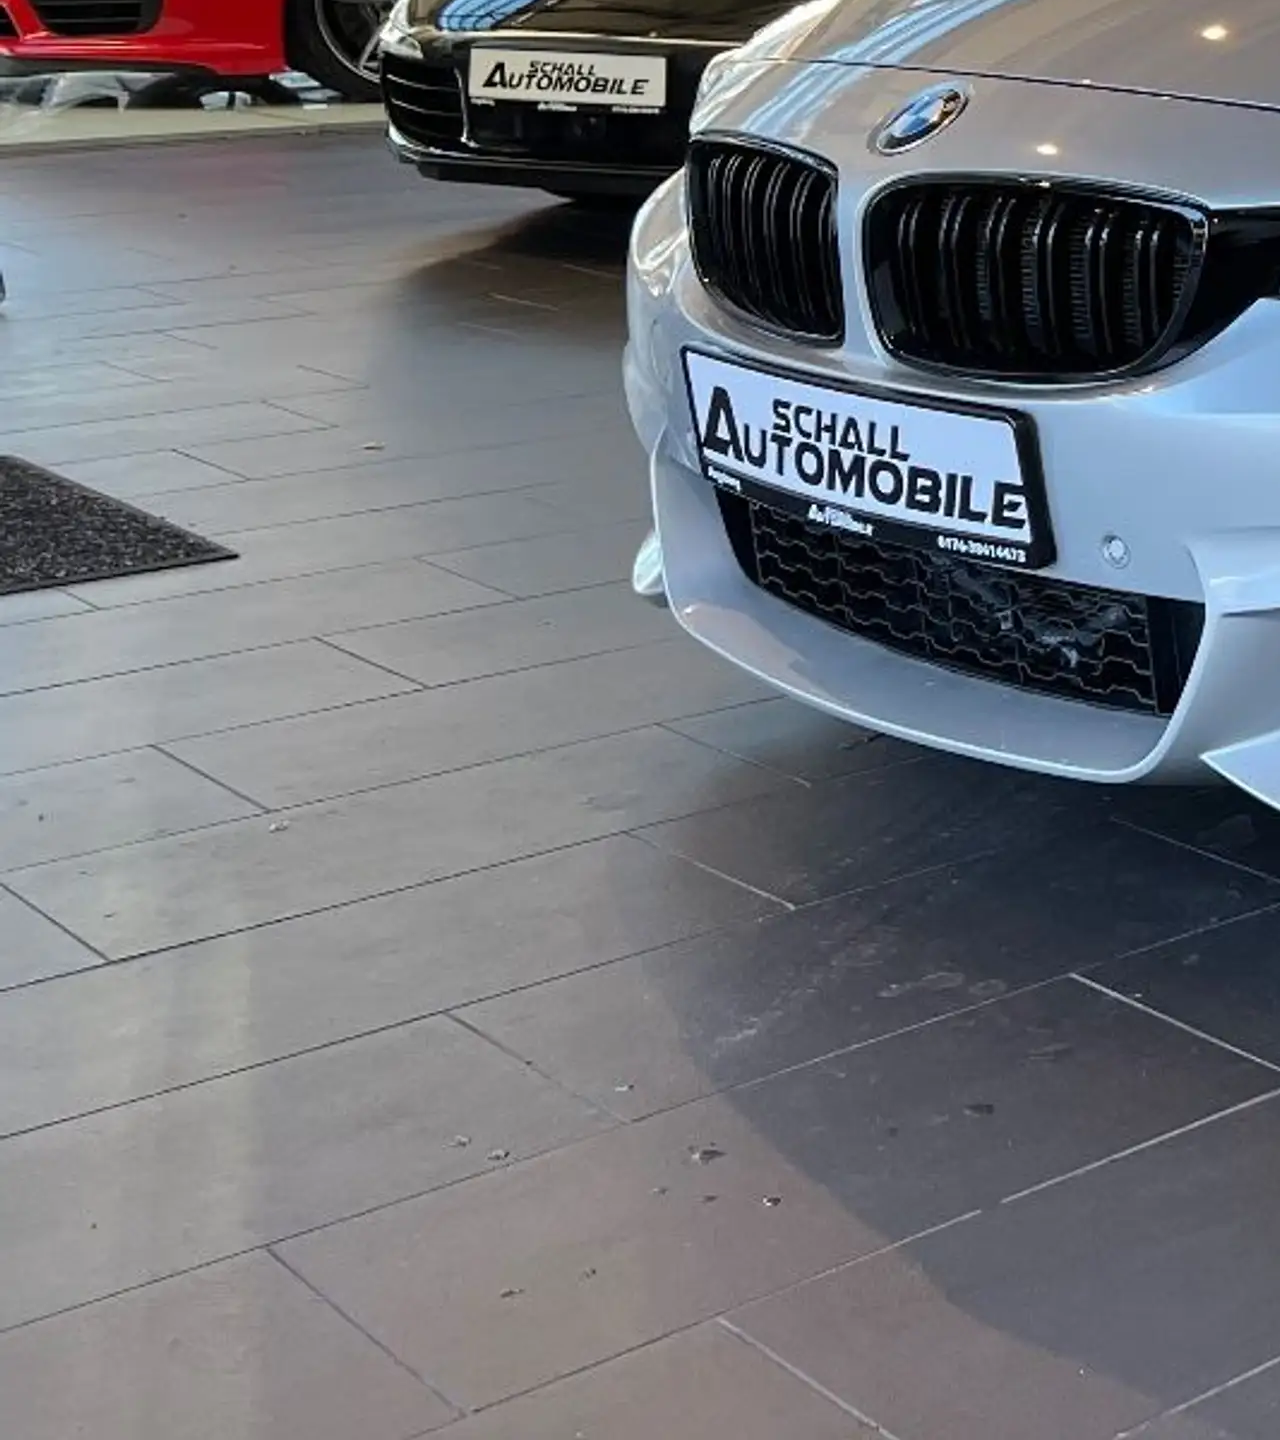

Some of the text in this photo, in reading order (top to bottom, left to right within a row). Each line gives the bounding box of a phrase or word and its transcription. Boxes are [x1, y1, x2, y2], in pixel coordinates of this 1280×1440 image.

[482, 62, 649, 95] AUTOMOBILE
[528, 61, 596, 76] SCHALL
[772, 398, 911, 461] SCHALL
[702, 385, 1027, 529] AUTOMOBILE
